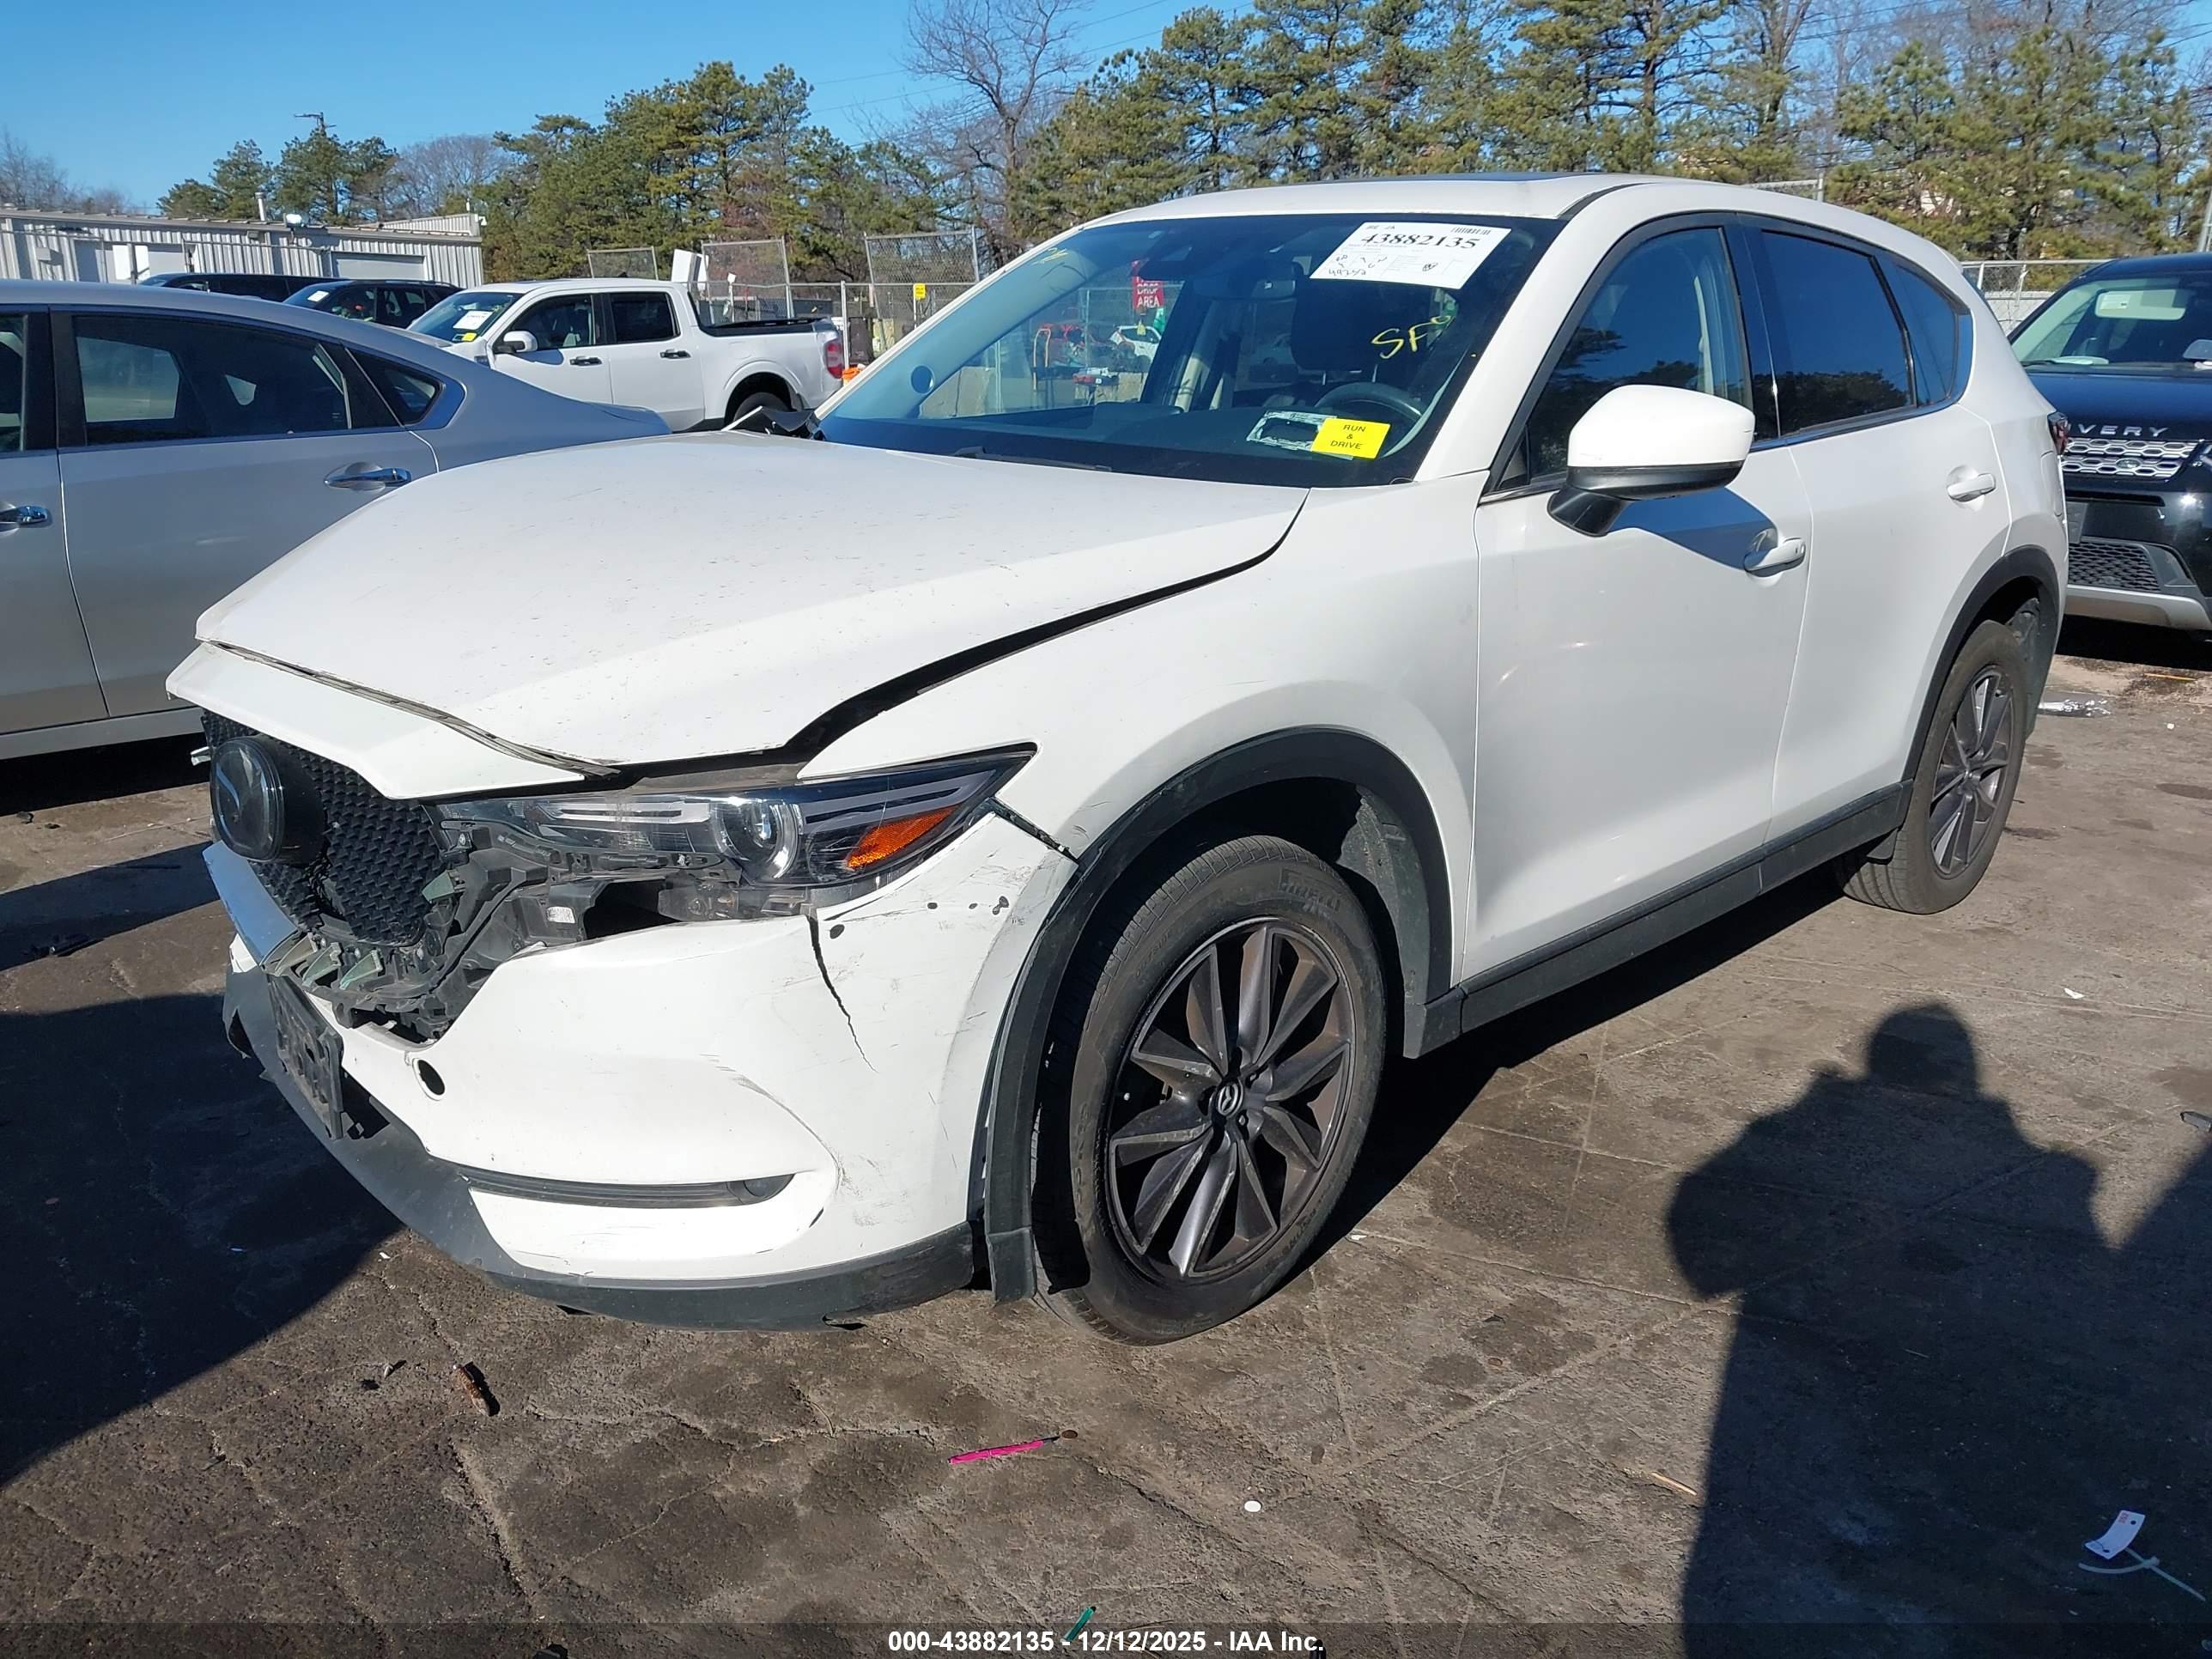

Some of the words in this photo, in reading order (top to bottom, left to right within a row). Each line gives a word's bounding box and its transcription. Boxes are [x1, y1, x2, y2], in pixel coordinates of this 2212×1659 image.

[1361, 233, 1480, 249] 43882135
[1137, 295, 1160, 308] AREA
[1330, 440, 1362, 449] DRIVE
